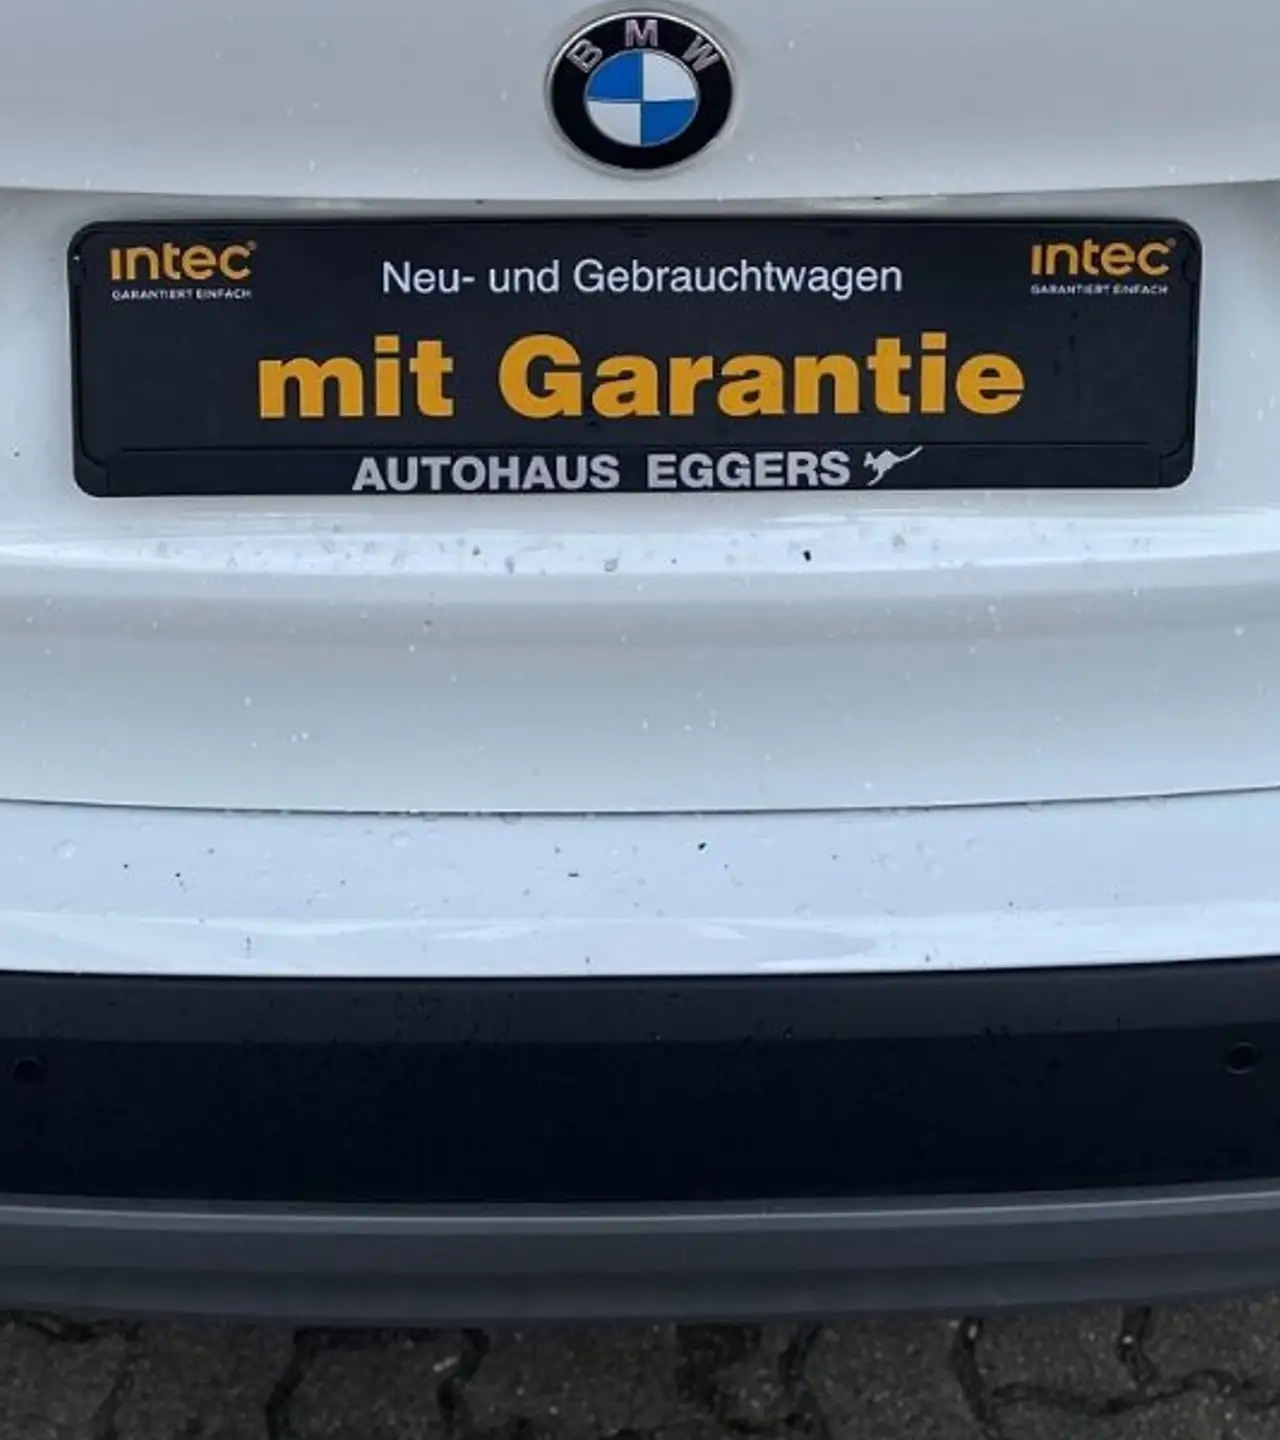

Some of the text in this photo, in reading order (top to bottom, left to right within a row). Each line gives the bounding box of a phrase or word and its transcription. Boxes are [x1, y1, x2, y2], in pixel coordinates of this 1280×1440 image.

[567, 19, 720, 75] BMW
[110, 242, 251, 281] intec
[1031, 238, 1170, 276] intec
[382, 258, 904, 300] Neu- und Gebrauchtwagen
[258, 332, 1025, 419] mit Garantie
[352, 451, 851, 492] AUTOHAUS EGGERS
